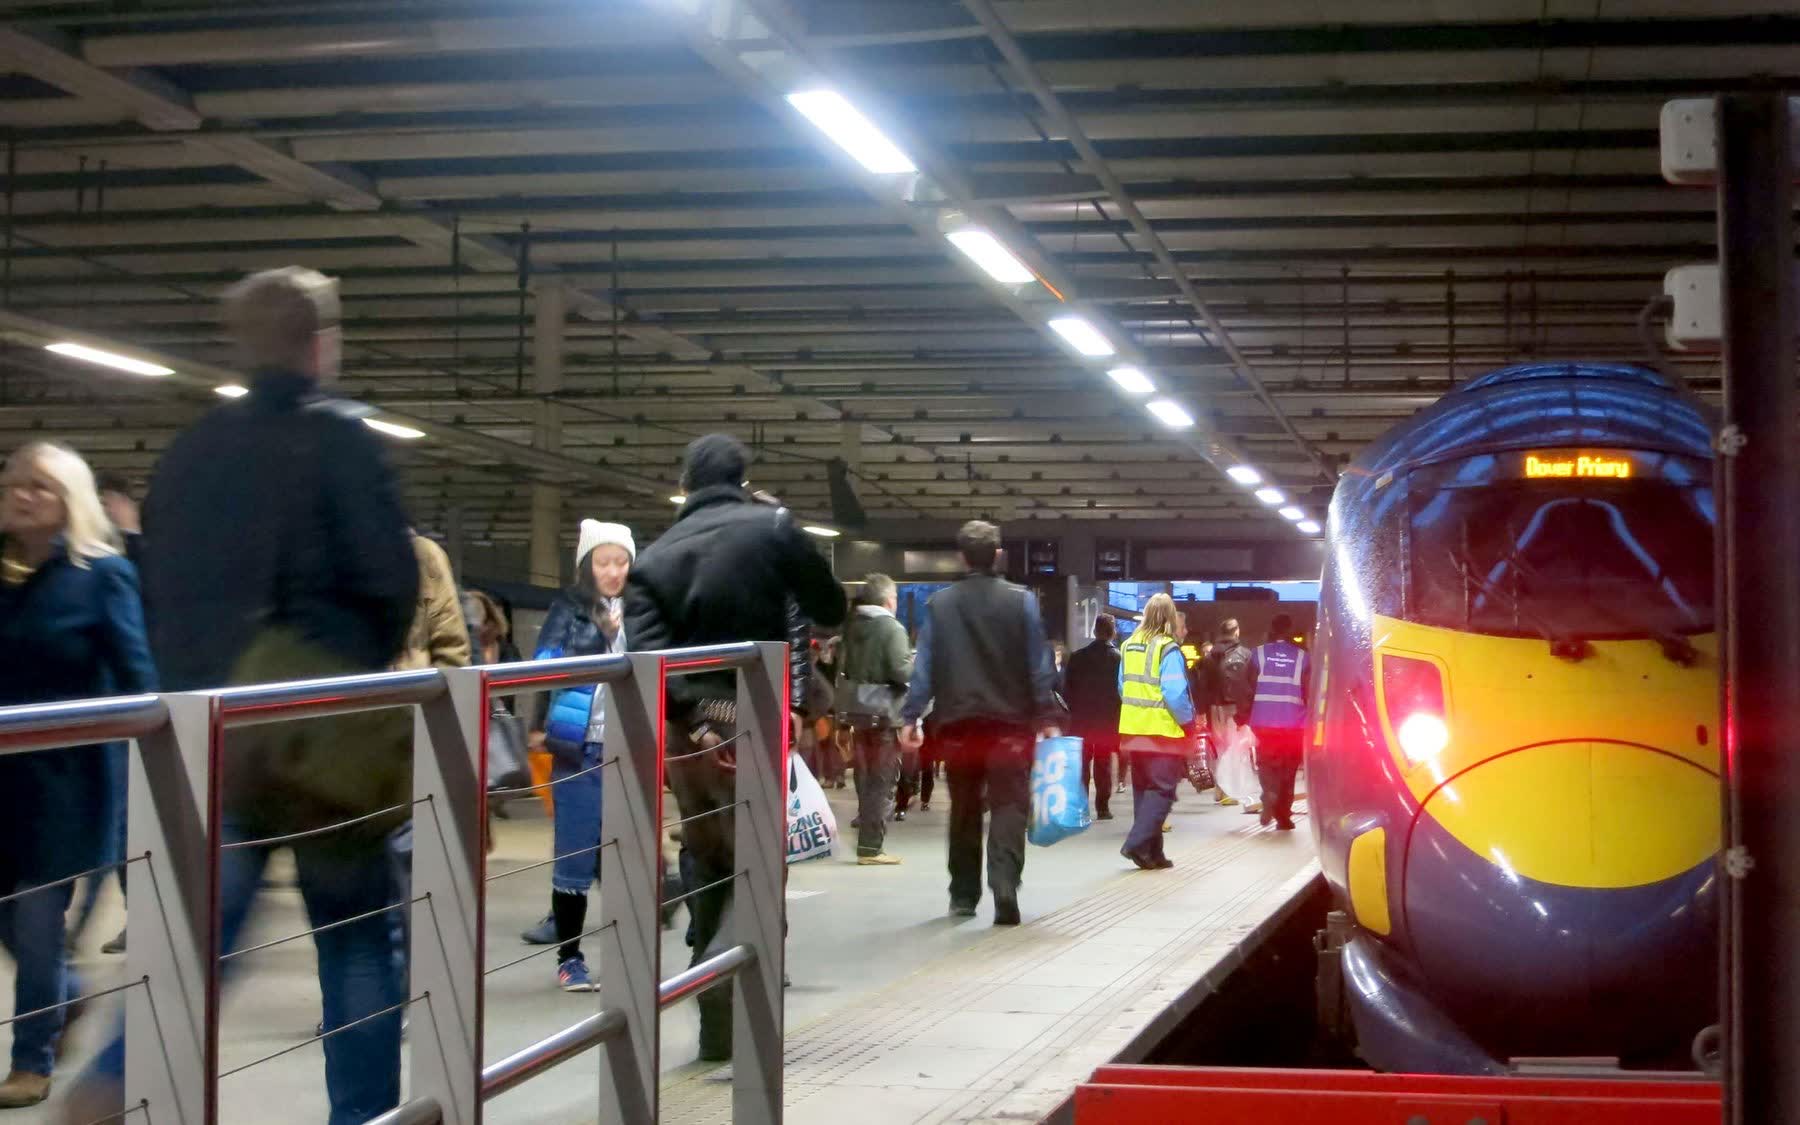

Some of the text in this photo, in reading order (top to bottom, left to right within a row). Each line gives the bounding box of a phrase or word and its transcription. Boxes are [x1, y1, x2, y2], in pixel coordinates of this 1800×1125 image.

[1526, 456, 1629, 478] Dover Priory
[788, 824, 831, 855] LUE!
